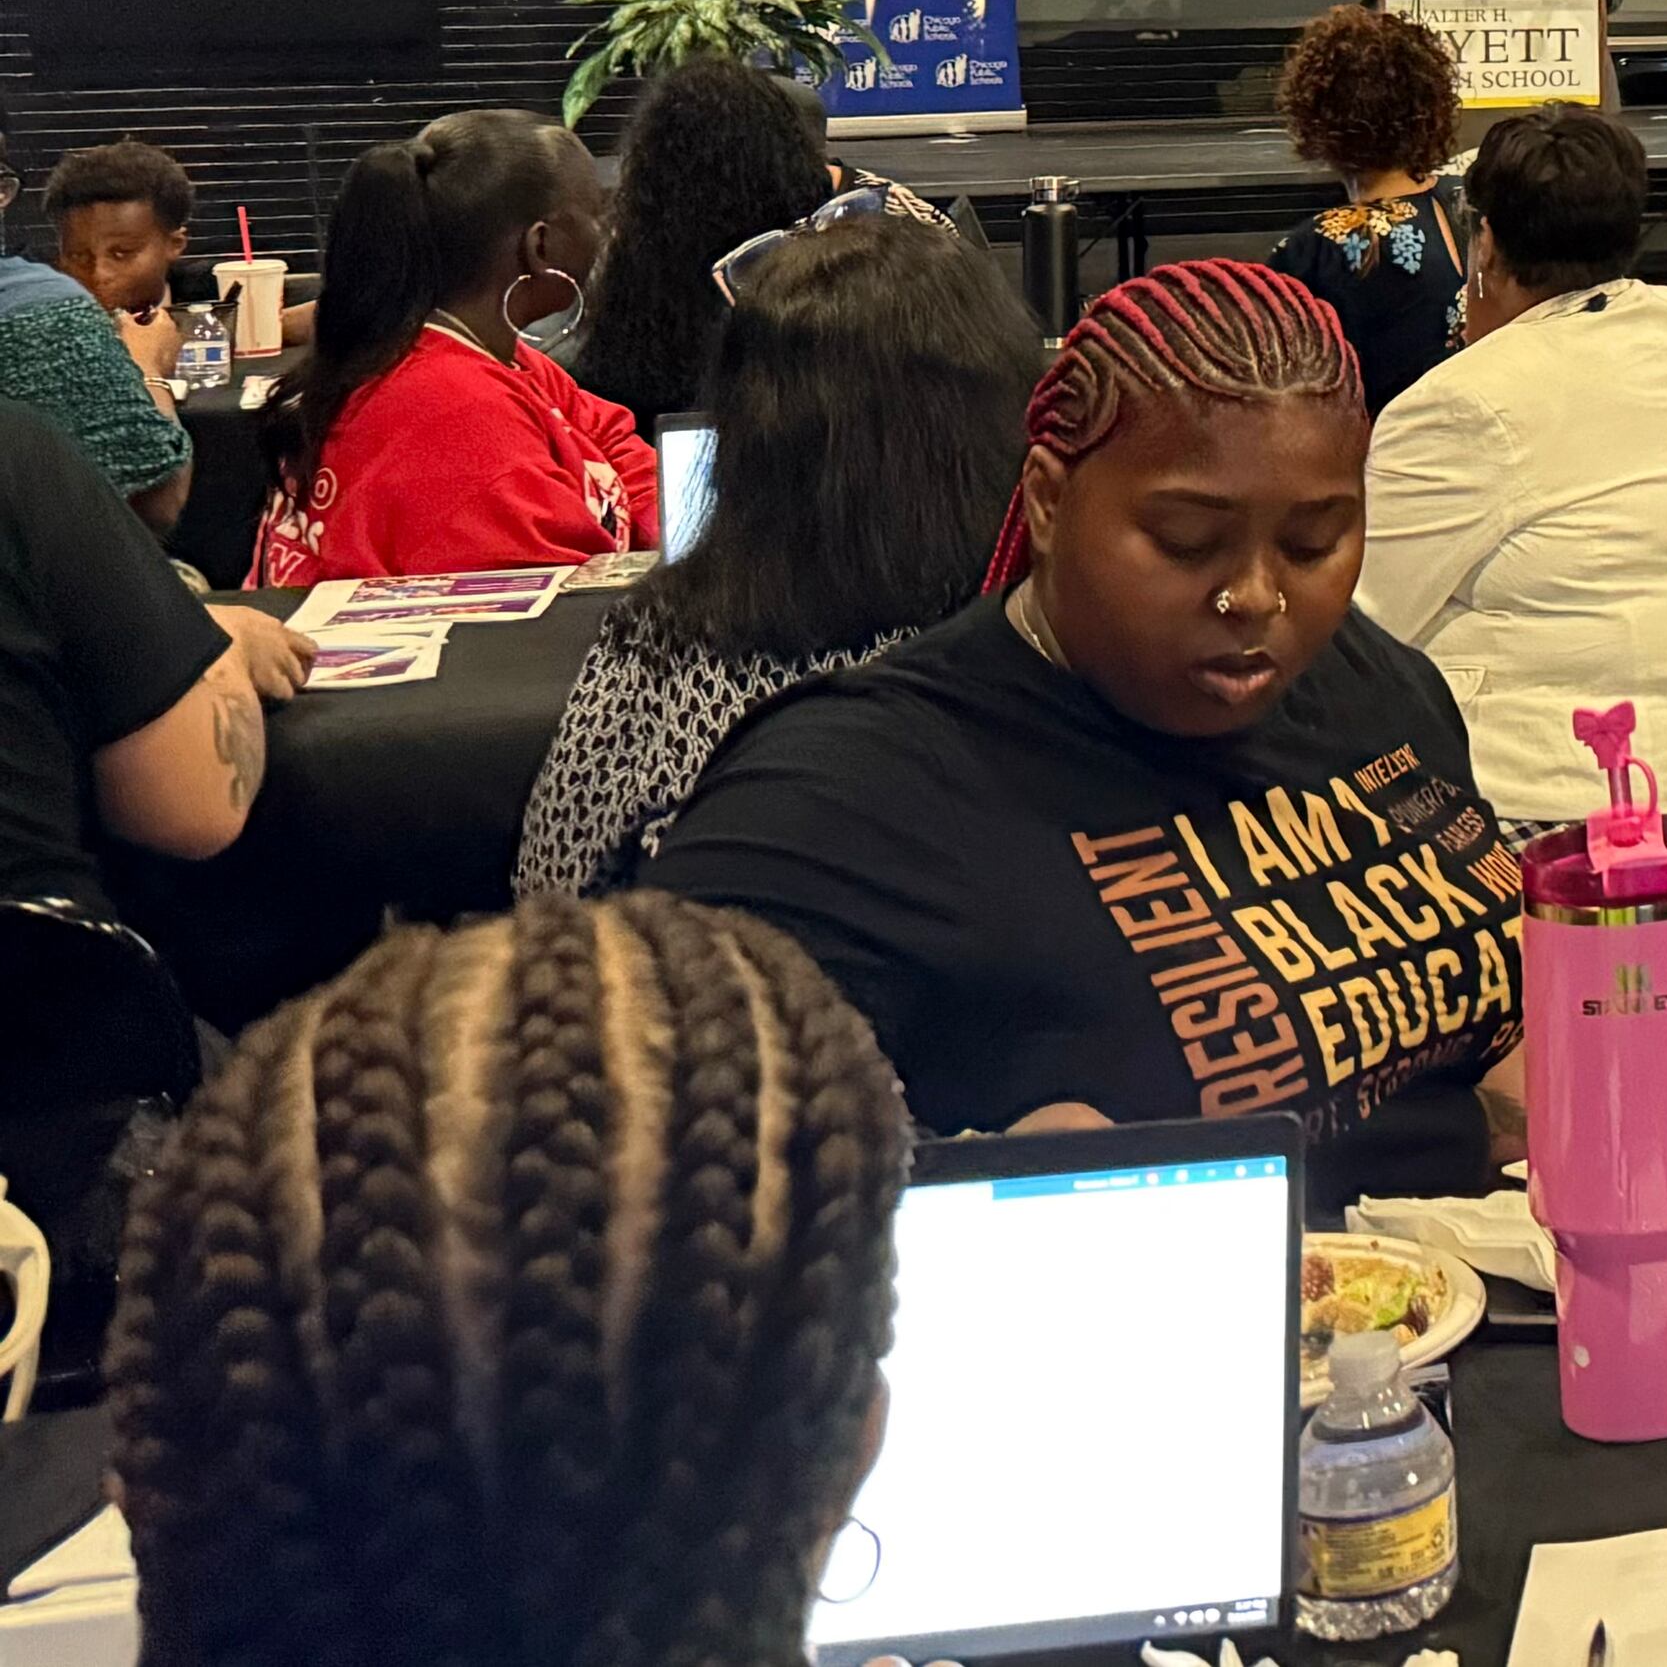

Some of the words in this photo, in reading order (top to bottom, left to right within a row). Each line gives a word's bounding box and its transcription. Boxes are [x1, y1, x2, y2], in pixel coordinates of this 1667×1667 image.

[1443, 27, 1580, 64] YETT
[1481, 69, 1582, 89] SCHOOL
[1172, 813, 1231, 900] I
[1228, 785, 1352, 887] AM
[1231, 843, 1488, 983] BLACK
[1069, 825, 1309, 1119] RESILIENT
